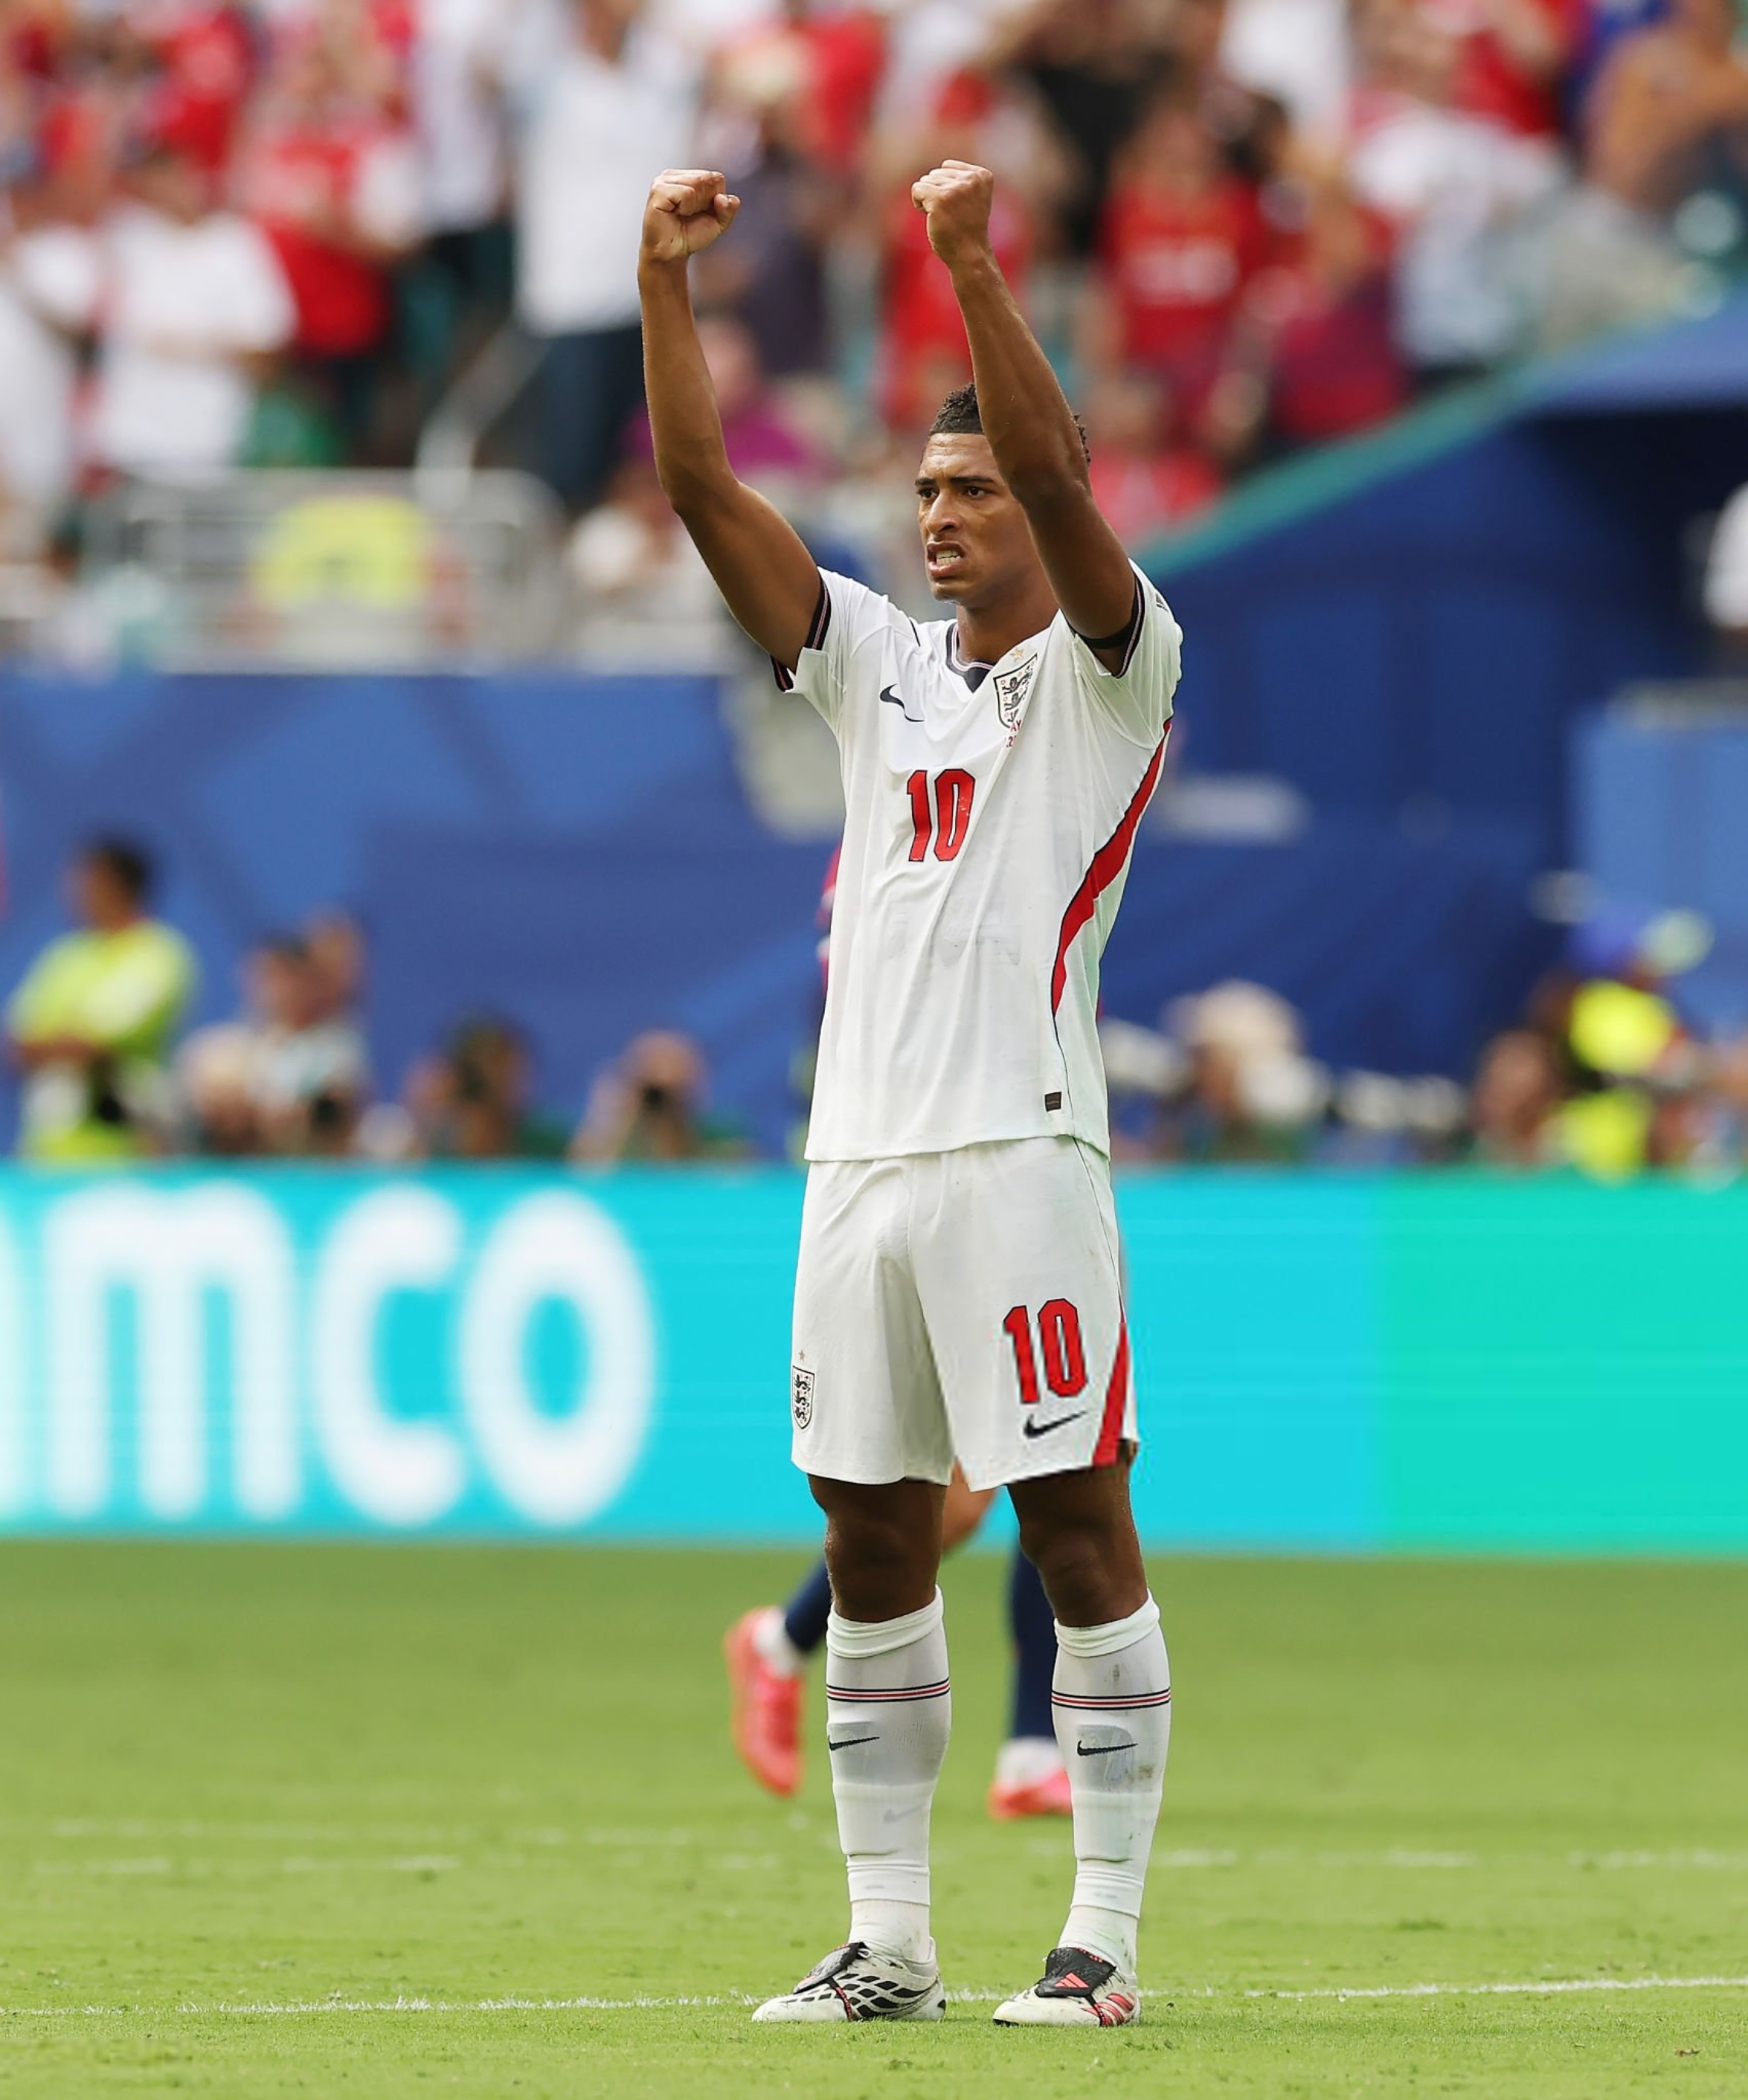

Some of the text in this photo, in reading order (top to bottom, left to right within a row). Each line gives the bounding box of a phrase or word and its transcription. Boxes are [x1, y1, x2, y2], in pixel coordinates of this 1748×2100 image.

[906, 768, 976, 862] 10
[0, 1179, 658, 1528] mco
[1003, 1298, 1087, 1405] 10
